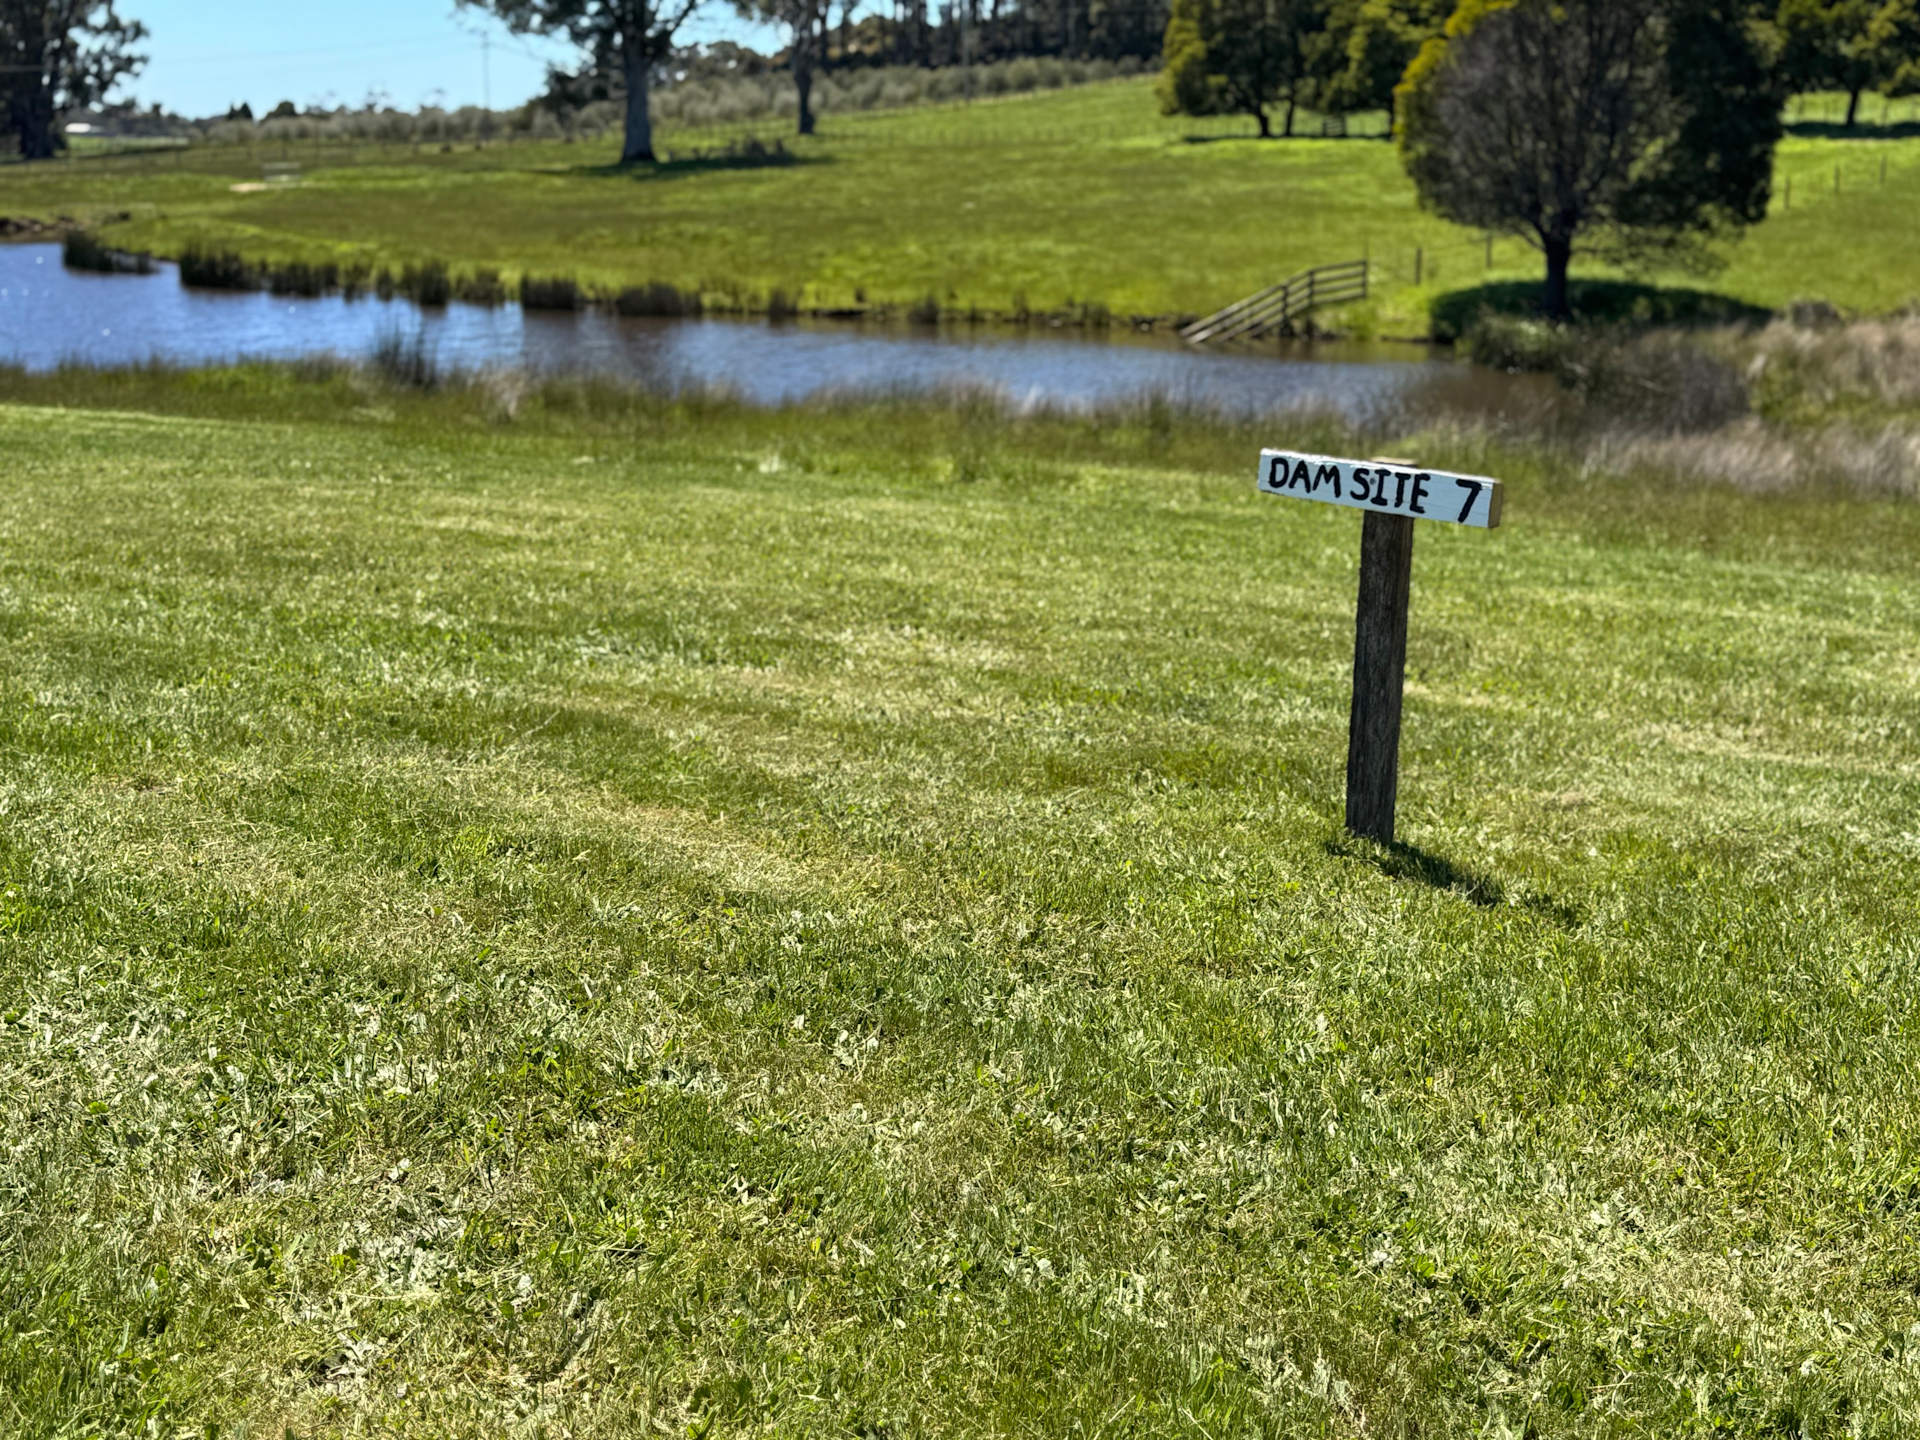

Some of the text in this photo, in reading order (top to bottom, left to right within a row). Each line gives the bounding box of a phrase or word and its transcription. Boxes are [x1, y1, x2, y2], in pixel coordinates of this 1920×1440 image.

[1268, 456, 1483, 524] DAM SITE 7
